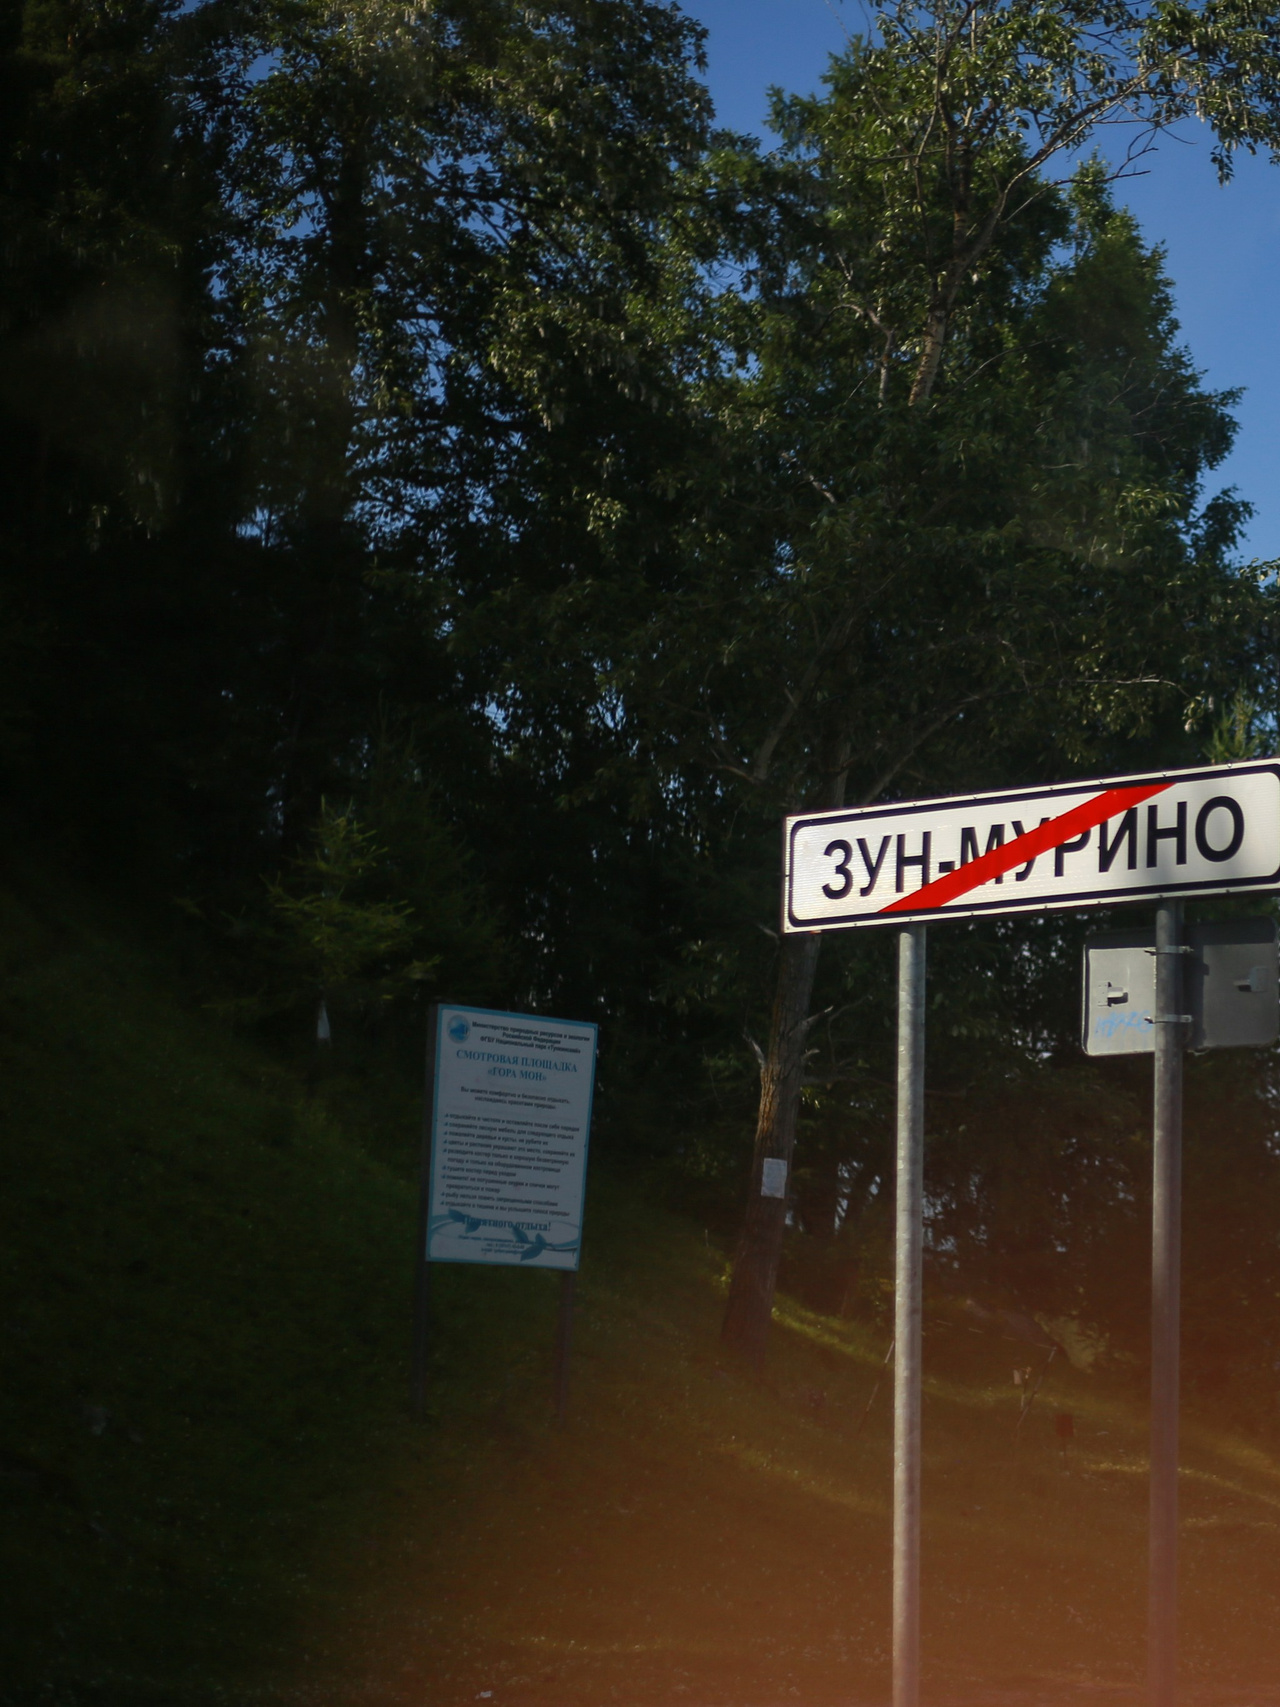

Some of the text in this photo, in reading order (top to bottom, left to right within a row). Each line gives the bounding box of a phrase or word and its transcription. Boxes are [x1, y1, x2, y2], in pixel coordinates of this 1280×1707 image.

[822, 795, 1245, 900] ЗУН-МУРИНО
[456, 1049, 578, 1074] СМОТРОВАЯ ПЛОЩАДКА
[516, 1219, 552, 1232] отдыха!
